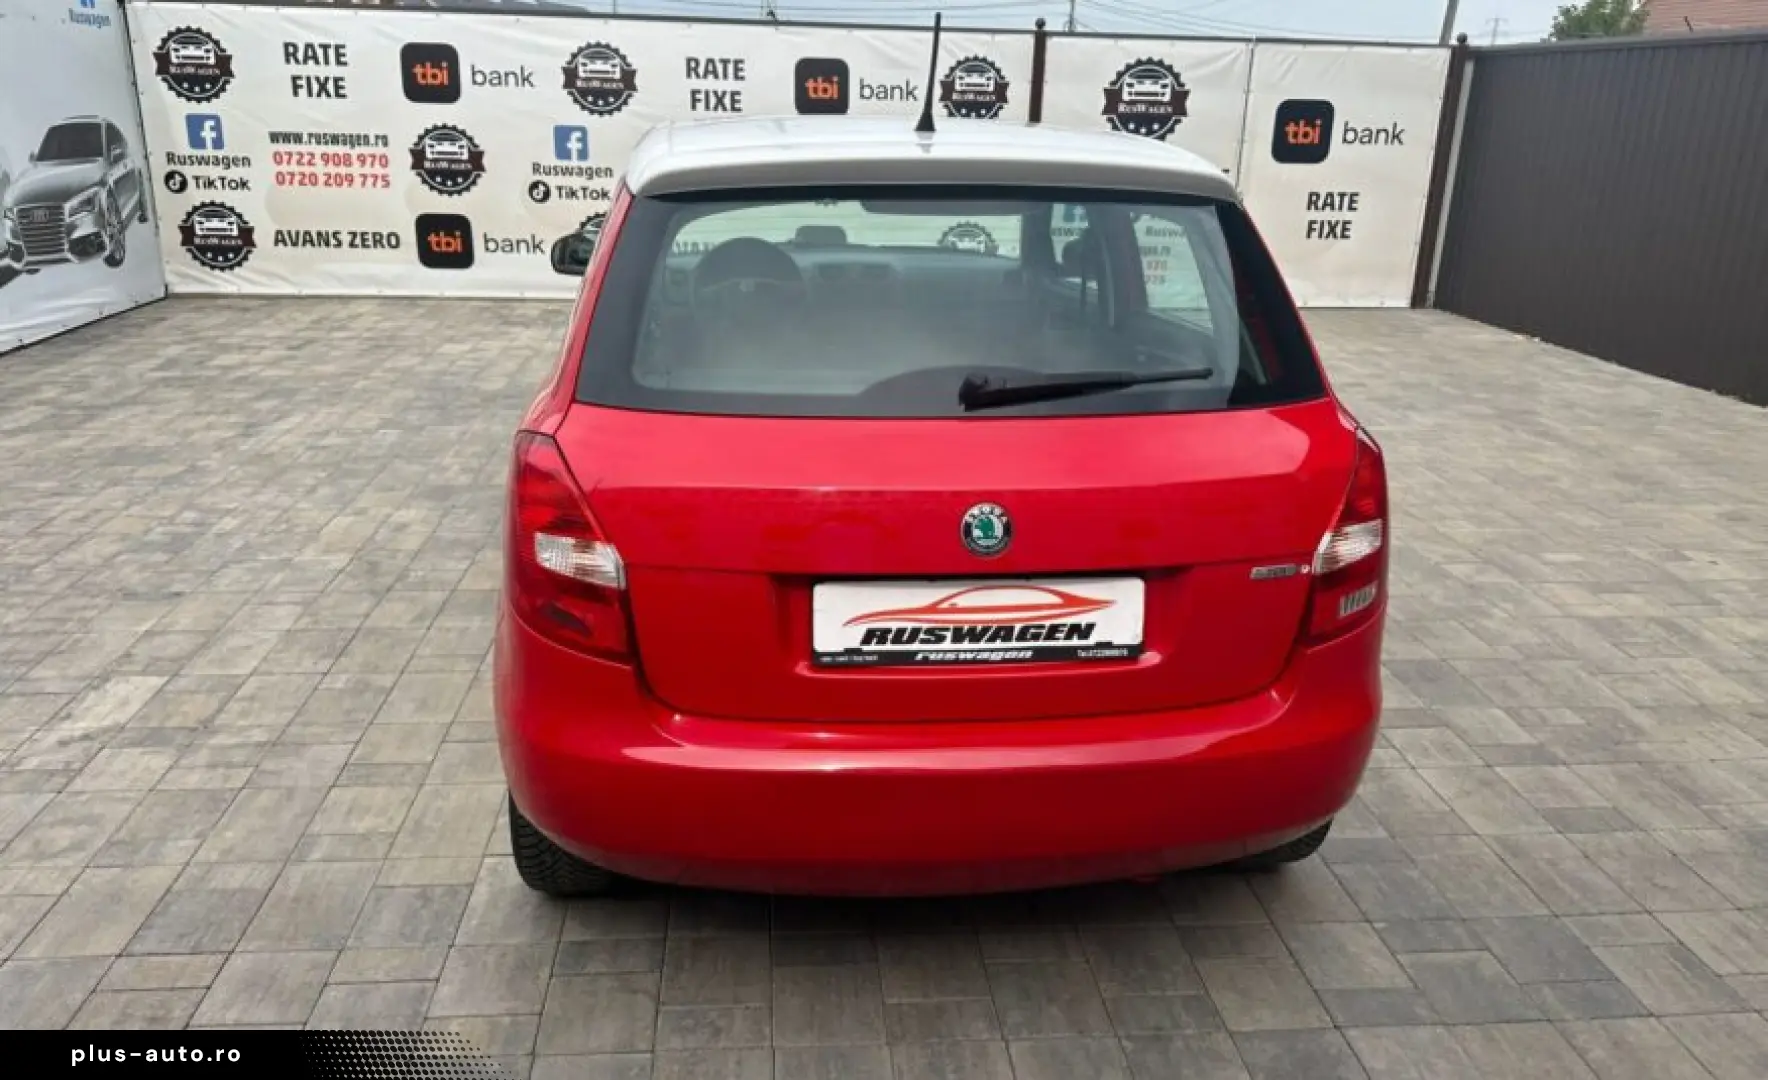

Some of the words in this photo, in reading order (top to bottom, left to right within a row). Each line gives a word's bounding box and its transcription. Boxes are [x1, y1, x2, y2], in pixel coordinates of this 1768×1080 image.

[283, 42, 348, 67] RATE
[412, 61, 449, 86] tbi
[471, 64, 535, 88] bank
[685, 56, 746, 81] RATE
[291, 75, 348, 99] FIXE
[805, 76, 839, 99] tbi
[859, 78, 919, 102] bank
[690, 89, 742, 112] FIXE
[268, 131, 389, 149] www.ruswagen.ro
[1284, 120, 1321, 145] tbi
[1341, 121, 1405, 146] bank
[166, 151, 251, 170] Ruswagen
[273, 151, 316, 167] 0722
[320, 152, 352, 167] 908
[356, 153, 389, 169] 970
[532, 161, 614, 180] Ruswagen
[191, 174, 252, 192] TikTok
[275, 171, 318, 187] 0720
[322, 173, 354, 188] 209
[359, 173, 391, 189] 775
[554, 184, 613, 202] TikTok
[1306, 191, 1360, 213] RATE
[273, 229, 344, 249] AVANS
[347, 231, 401, 250] ZERO
[1306, 219, 1353, 240] FIXE
[427, 231, 464, 254] tbi
[483, 232, 545, 255] bank
[860, 623, 1096, 646] RUSWAGEN
[915, 649, 1033, 662] ruswagen
